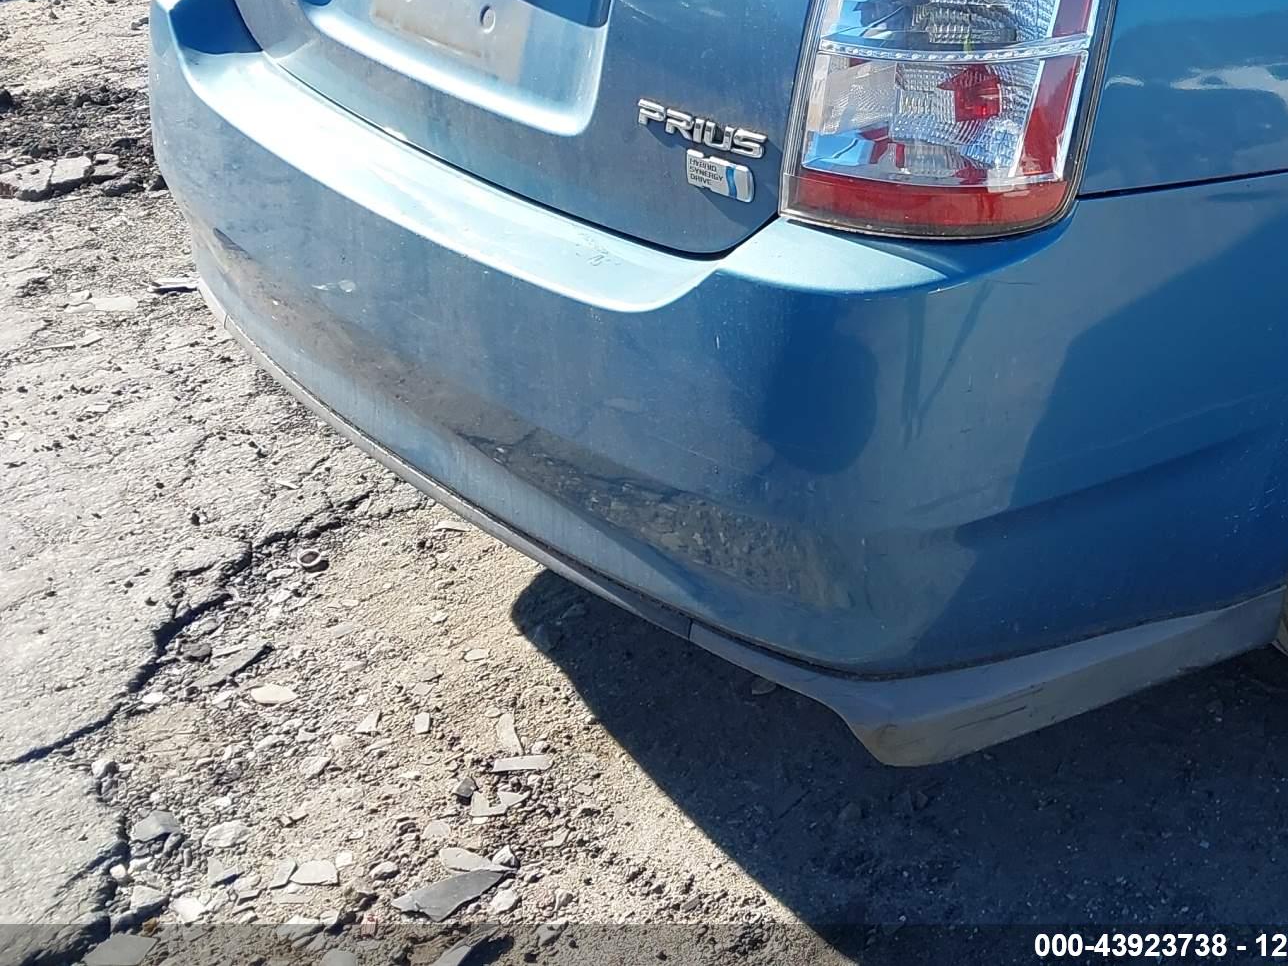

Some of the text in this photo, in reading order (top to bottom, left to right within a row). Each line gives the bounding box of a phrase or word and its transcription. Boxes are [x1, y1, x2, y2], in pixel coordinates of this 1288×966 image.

[638, 98, 767, 158] PRIUS
[689, 158, 717, 172] HYBRID
[689, 165, 724, 182] SYNERGY
[690, 173, 712, 186] DRIVE
